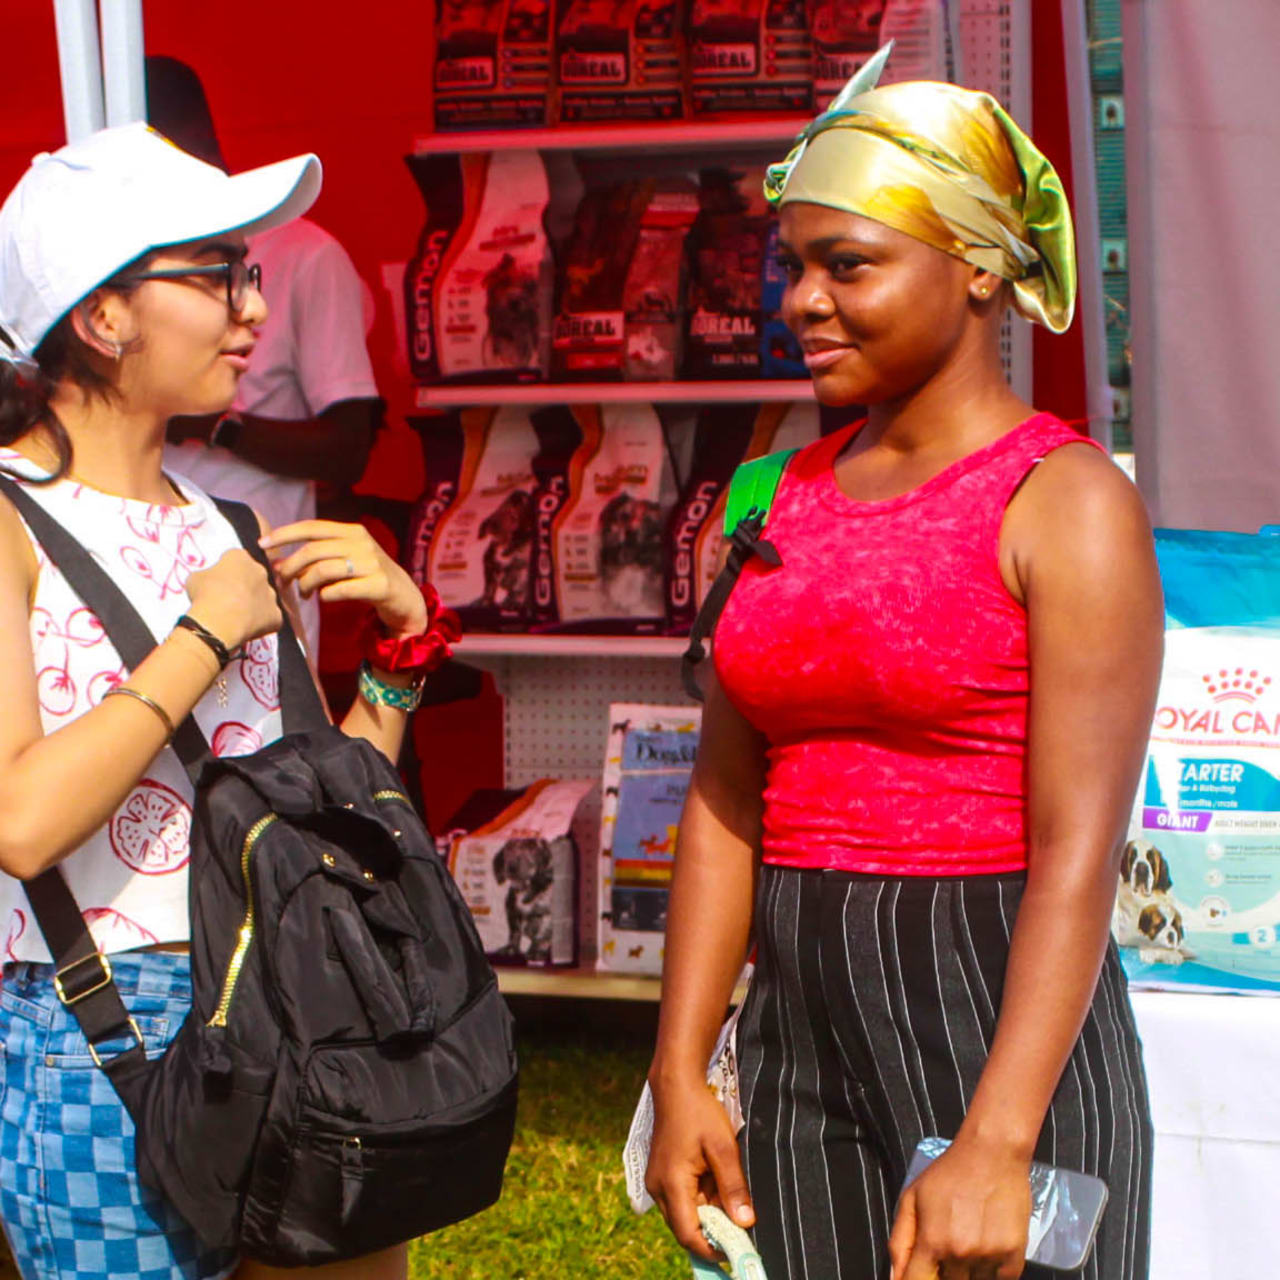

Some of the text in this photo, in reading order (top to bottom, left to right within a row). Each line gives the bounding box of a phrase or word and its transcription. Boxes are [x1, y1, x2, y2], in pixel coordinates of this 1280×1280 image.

[413, 228, 449, 362] Gemon
[535, 473, 565, 606] Gemon
[672, 480, 718, 607] Gemon
[1154, 706, 1225, 735] OYAL
[1178, 762, 1245, 783] TARTER
